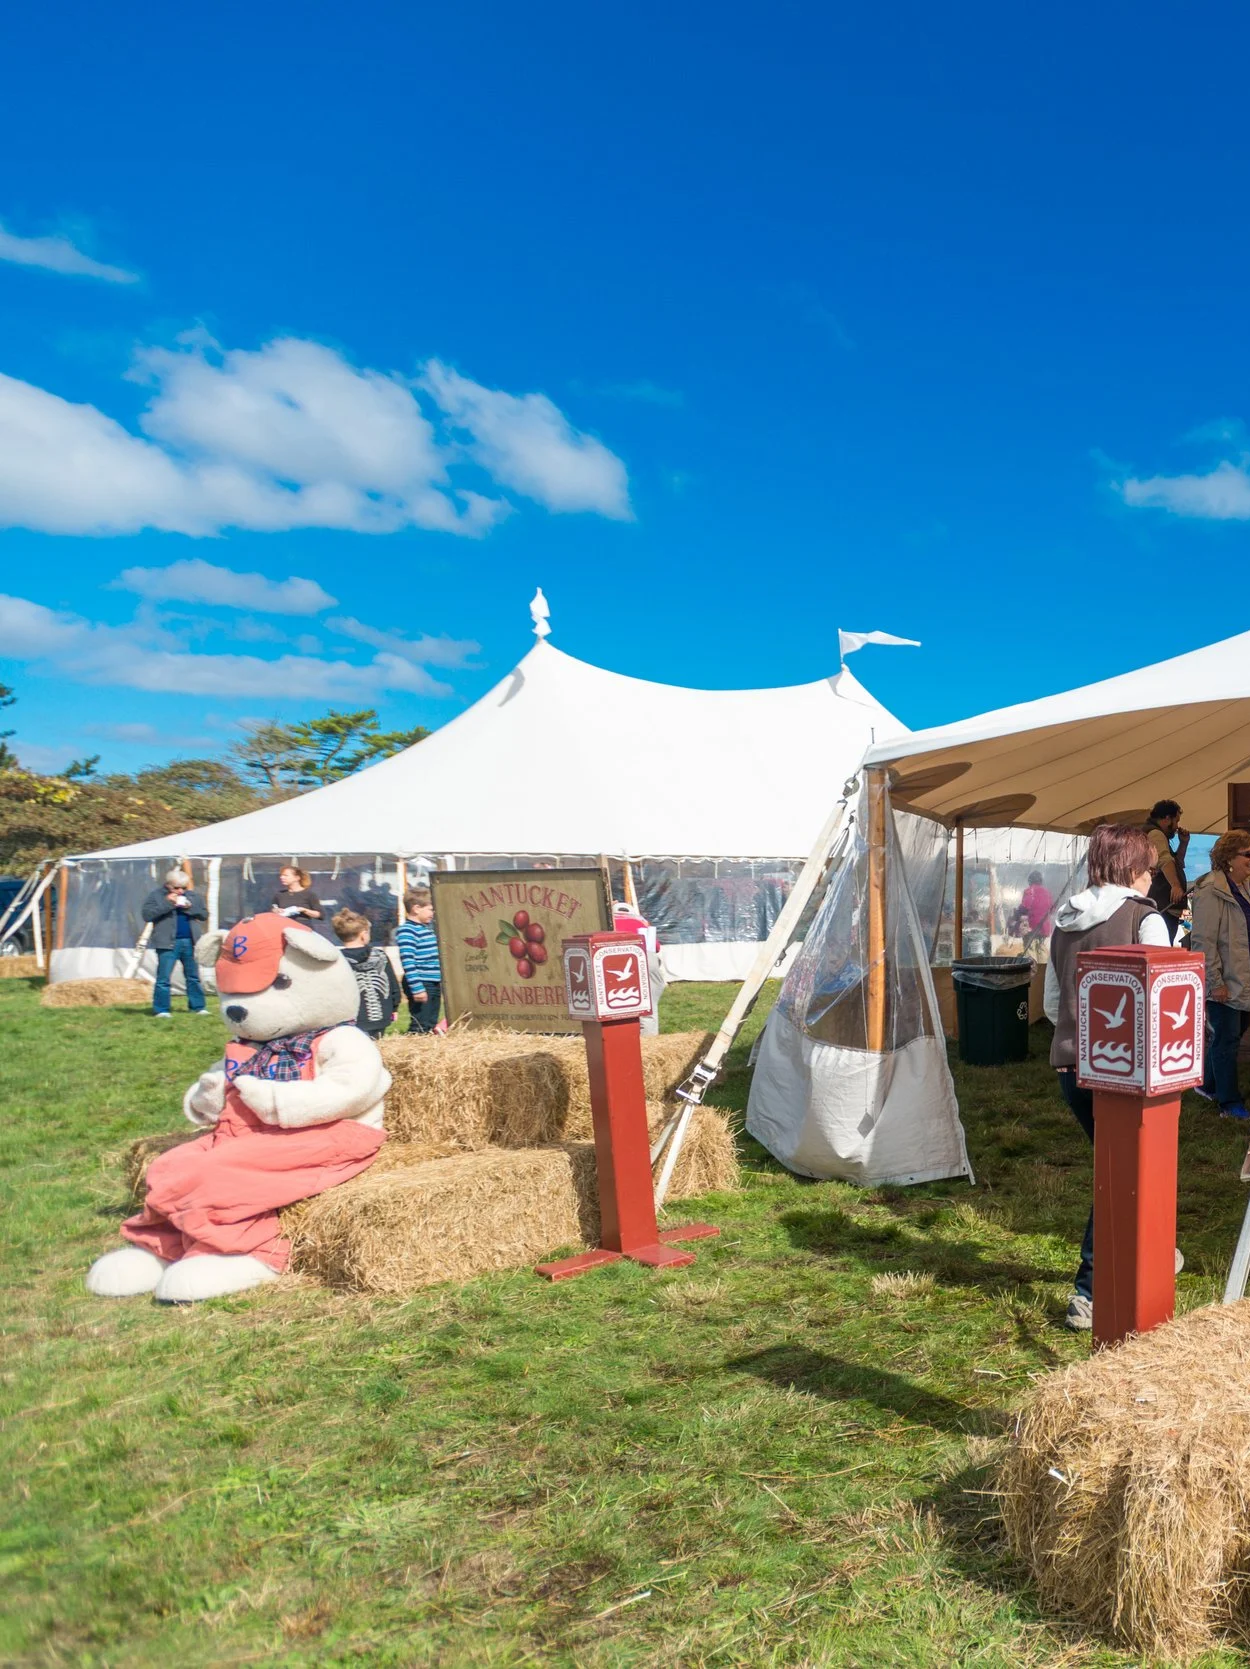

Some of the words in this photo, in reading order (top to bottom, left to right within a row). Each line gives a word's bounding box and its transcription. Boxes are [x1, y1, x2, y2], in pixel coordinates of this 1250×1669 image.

[462, 883, 582, 920] NANTUCKET
[232, 936, 248, 958] B
[596, 946, 643, 961] CONSERVATION
[595, 965, 605, 1005] NANTUCKET
[639, 961, 649, 1000] FOUNDATION
[1081, 972, 1143, 995] CONSERVATION
[1153, 973, 1201, 994] CONSERVATION
[477, 982, 568, 1007] CRANBERR
[1136, 1001, 1144, 1069] FOUNDATION
